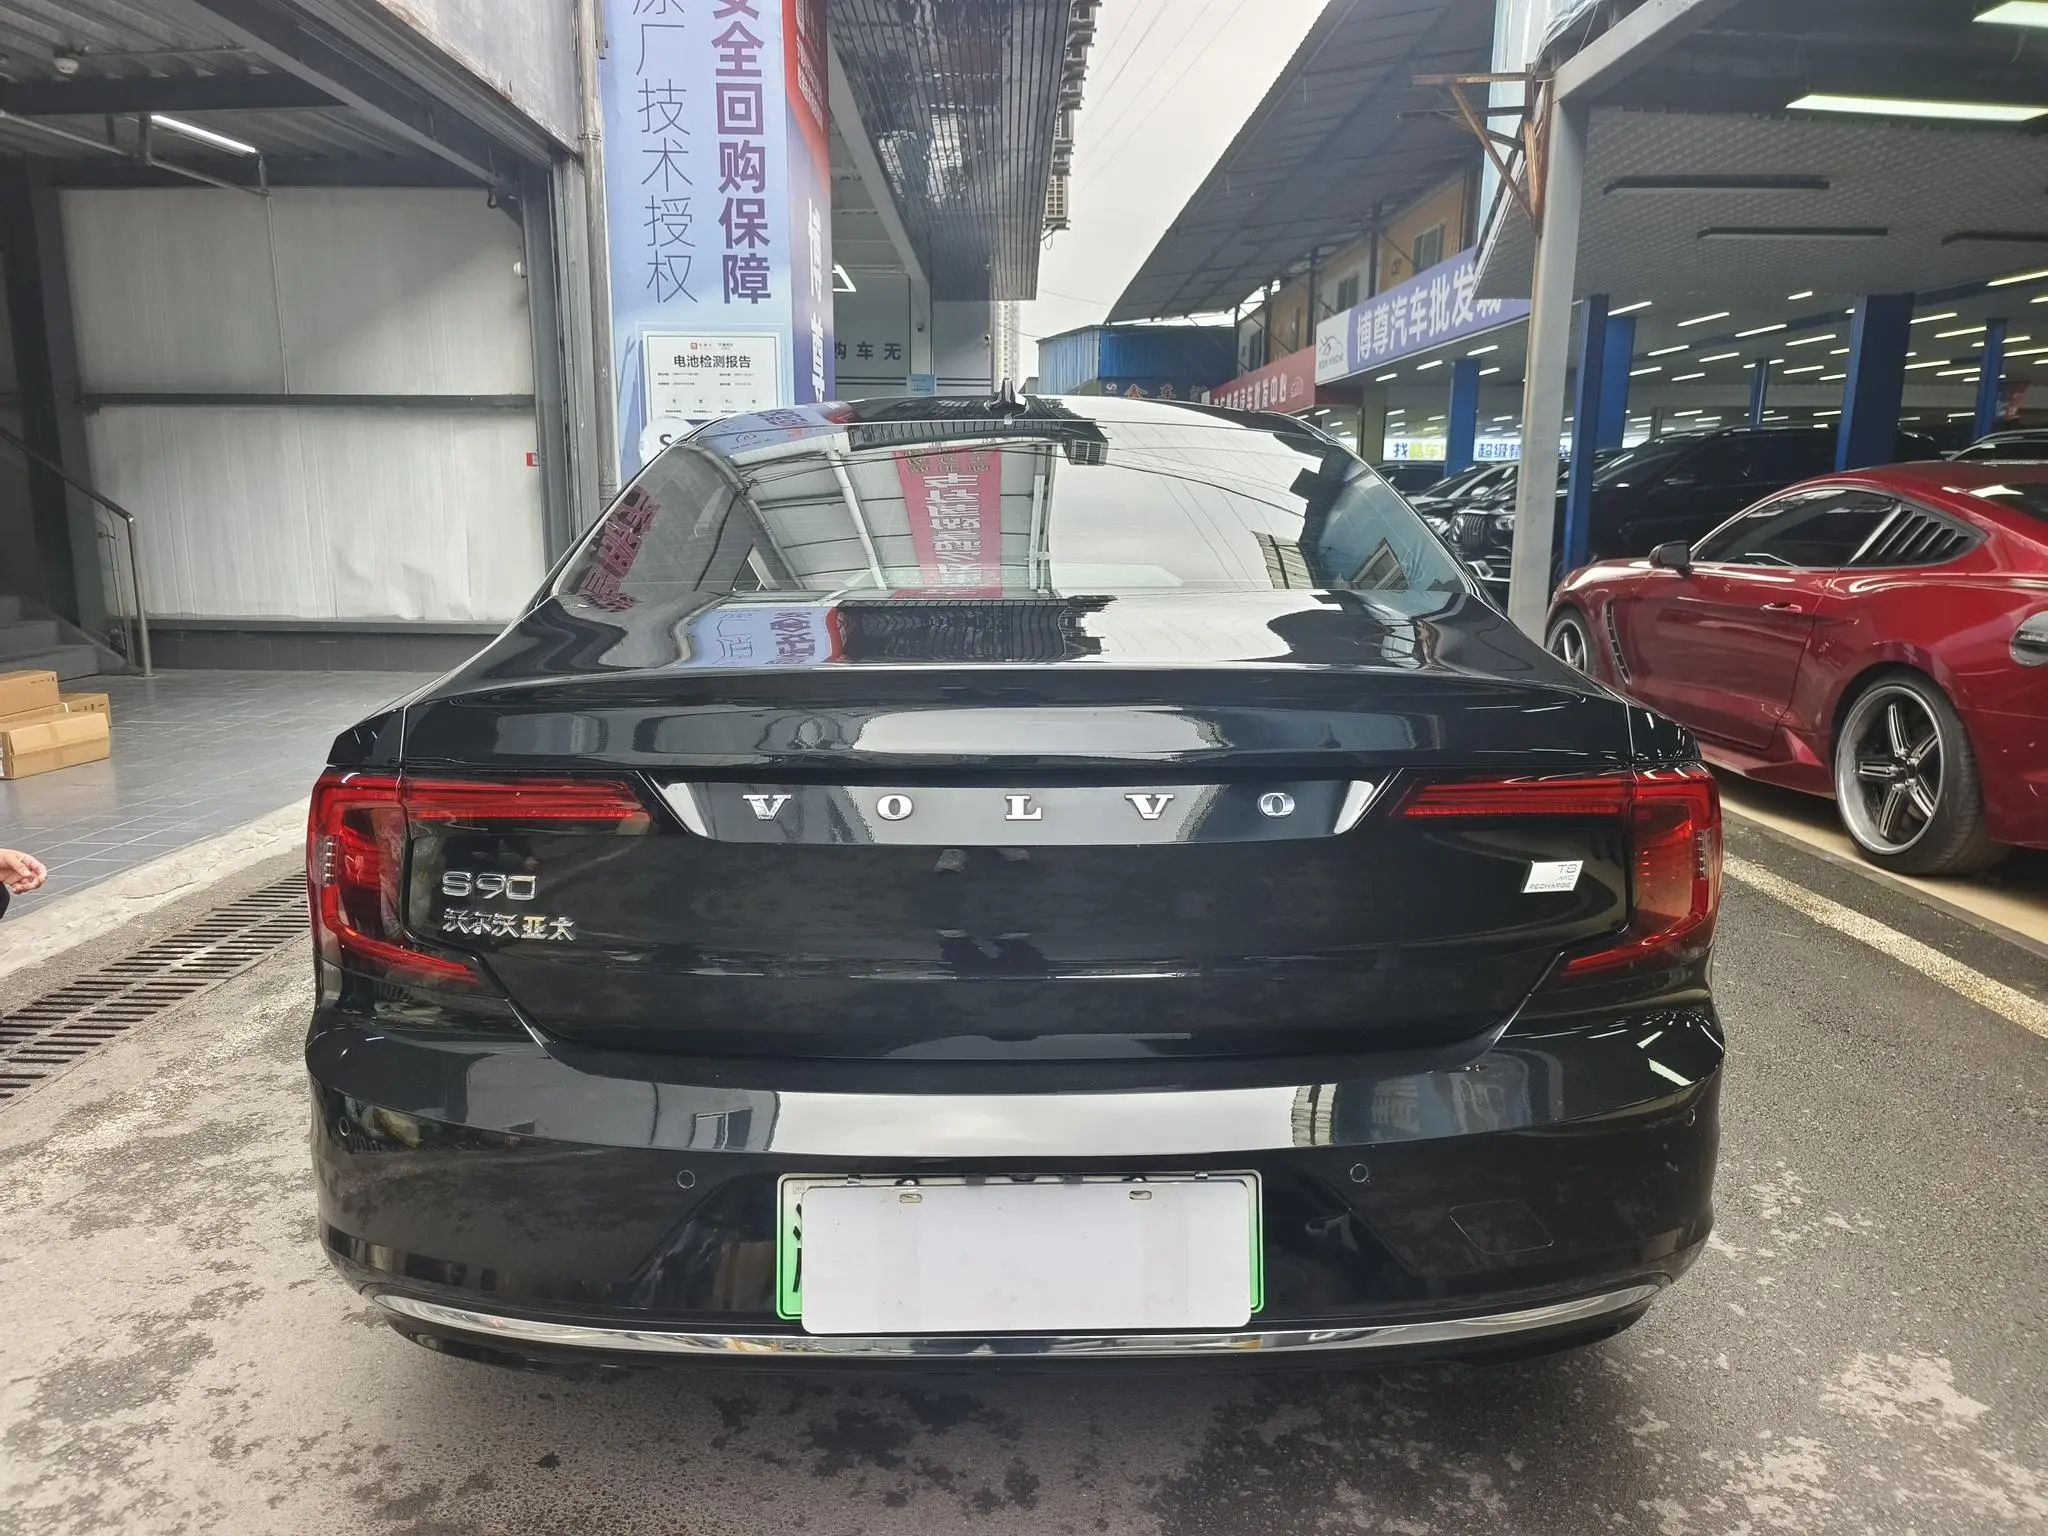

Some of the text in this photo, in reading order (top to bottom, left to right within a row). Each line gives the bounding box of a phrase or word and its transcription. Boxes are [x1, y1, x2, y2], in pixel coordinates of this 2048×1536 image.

[632, 0, 698, 304] 厂技术授权
[673, 354, 752, 369] 电池检测报告
[742, 792, 1296, 822] VOLVO
[1558, 863, 1578, 874] T8
[442, 871, 537, 901] S90
[1528, 881, 1572, 890] RECHARGE
[442, 907, 577, 941] 沃尔沃亚太
